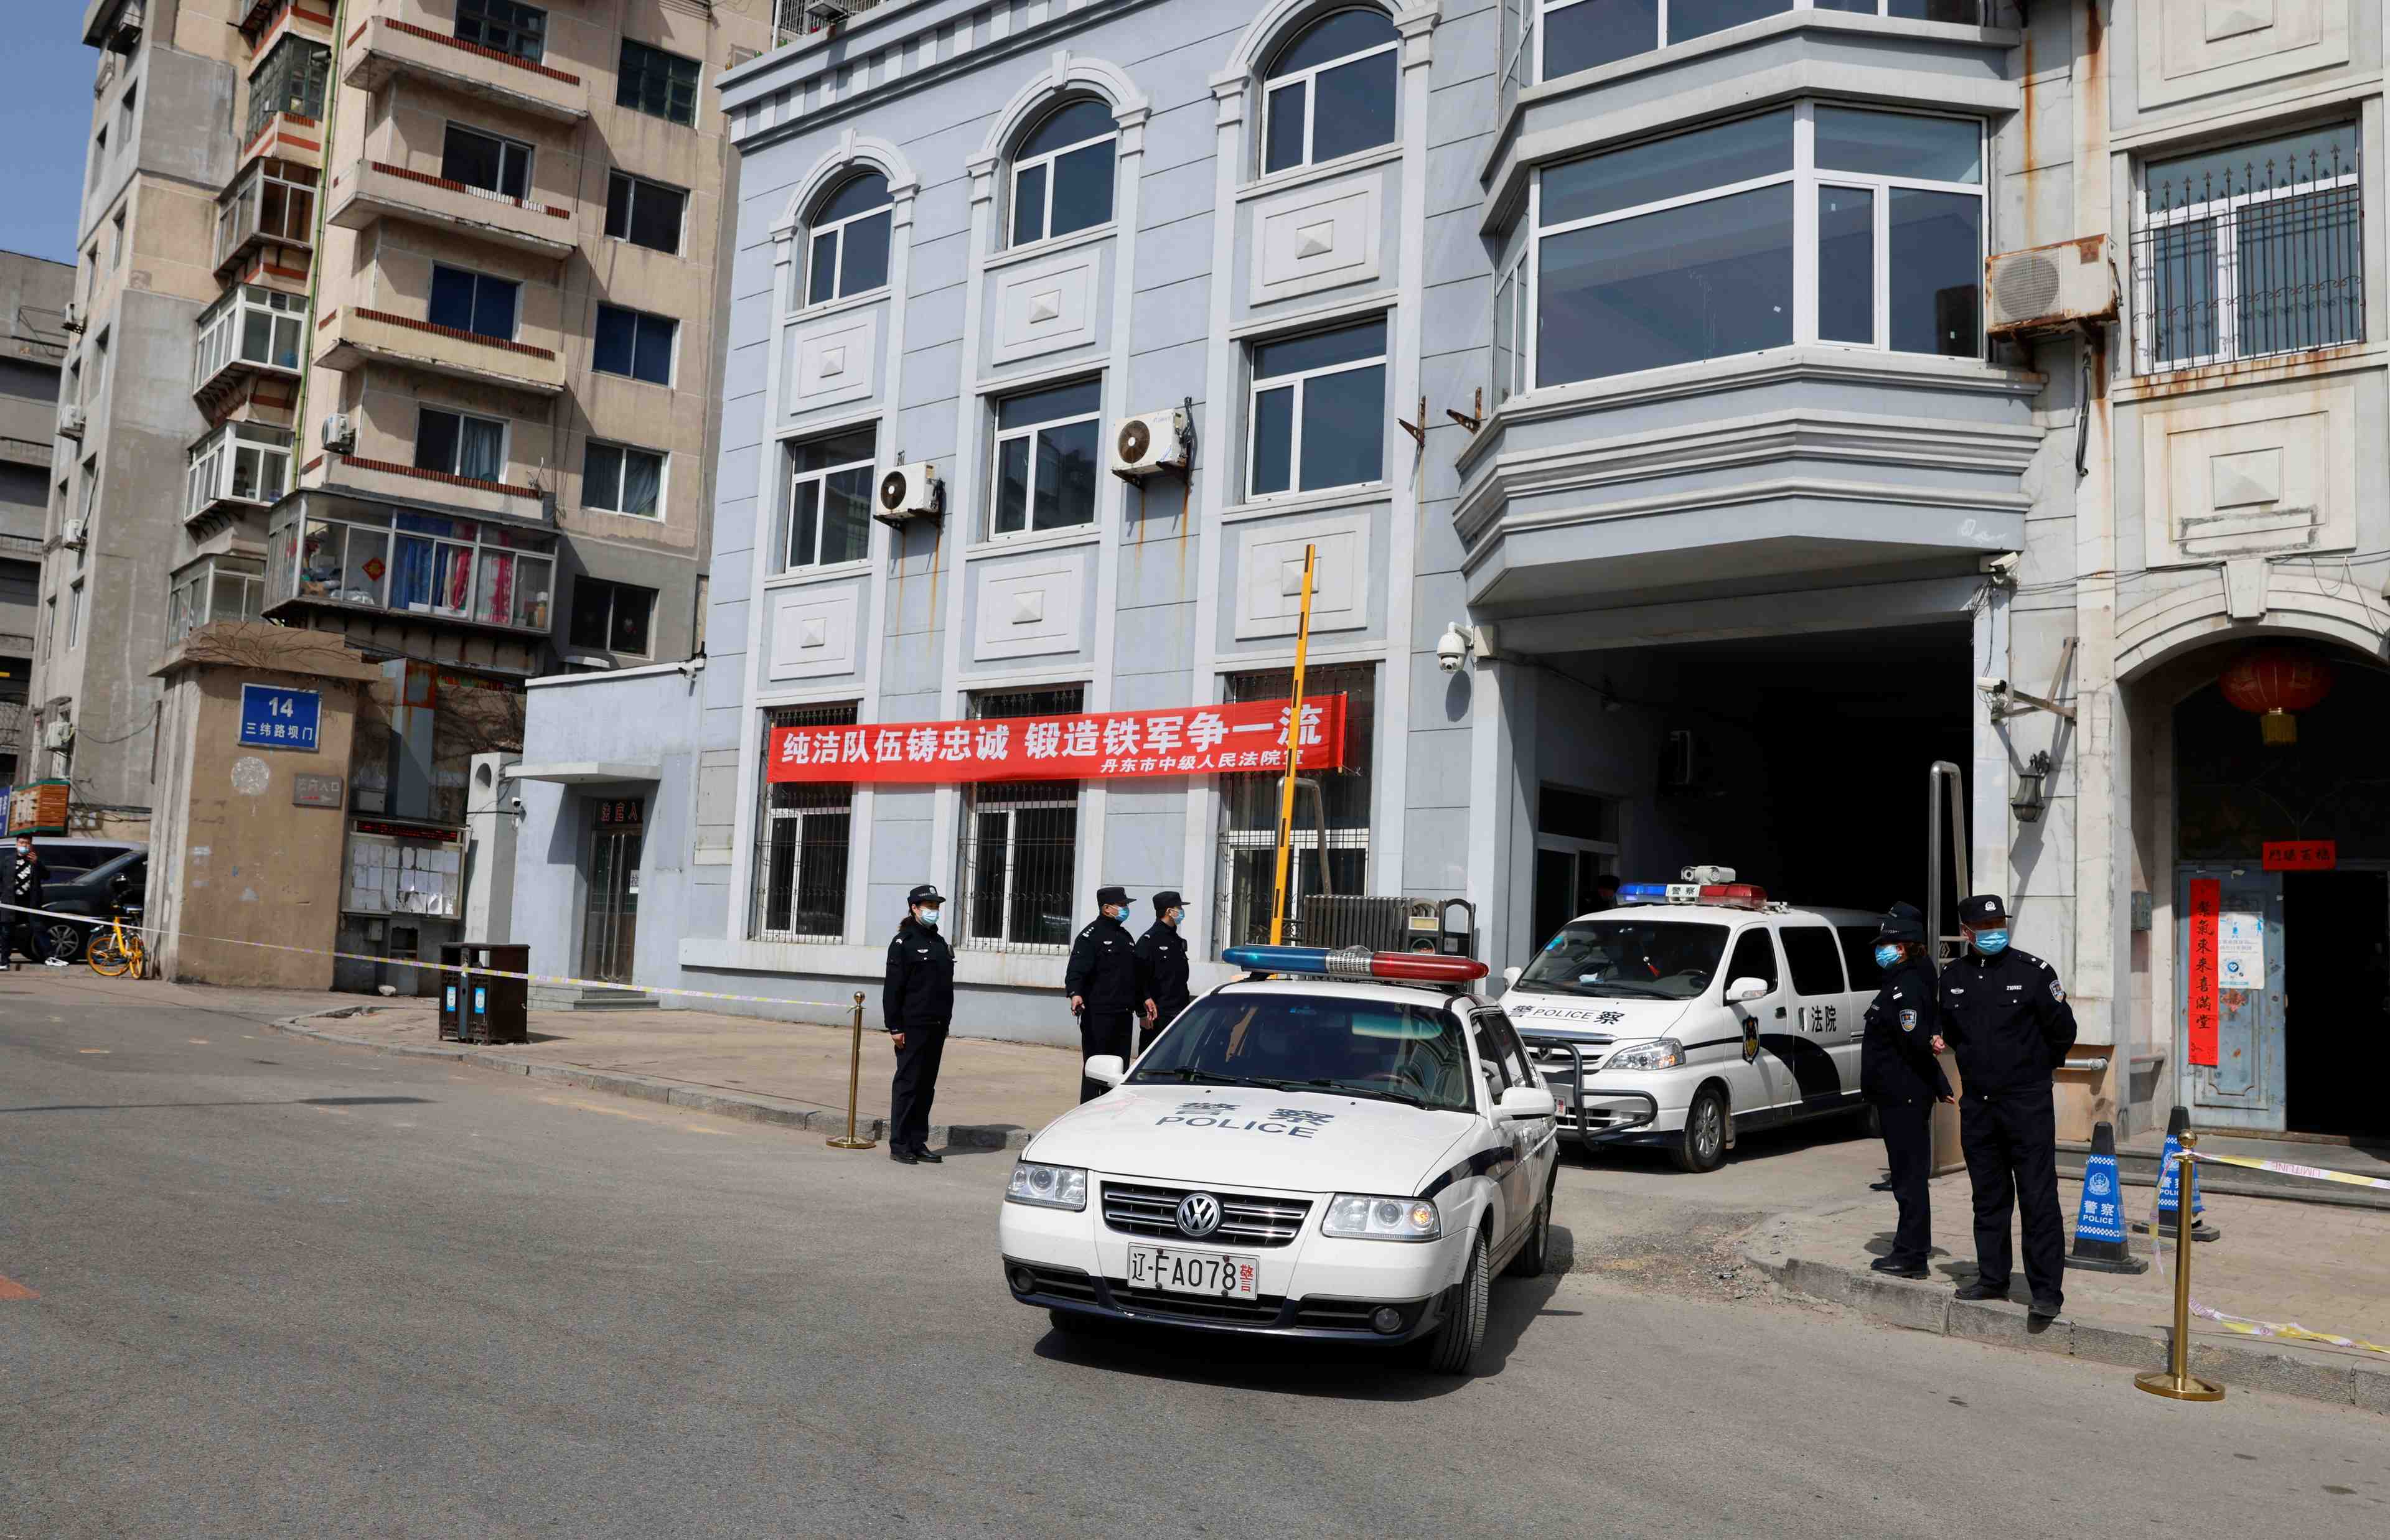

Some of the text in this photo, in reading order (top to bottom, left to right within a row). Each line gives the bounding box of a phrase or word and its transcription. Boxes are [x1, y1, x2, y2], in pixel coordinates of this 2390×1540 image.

[268, 696, 294, 717] 14
[246, 722, 313, 740] 三纬路坝门
[782, 704, 1323, 764] 纯洁队伍铸忠诚 锻造铁军争一流
[1672, 885, 1695, 895] 警察
[1534, 1008, 1595, 1020] POLICE
[1593, 1010, 1626, 1025] 察
[1811, 1005, 1837, 1033] 法院
[1175, 1102, 1335, 1126] 警察
[1155, 1116, 1319, 1139] POLICE
[2084, 1200, 2115, 1216] 警察
[2083, 1215, 2114, 1225] POLICE
